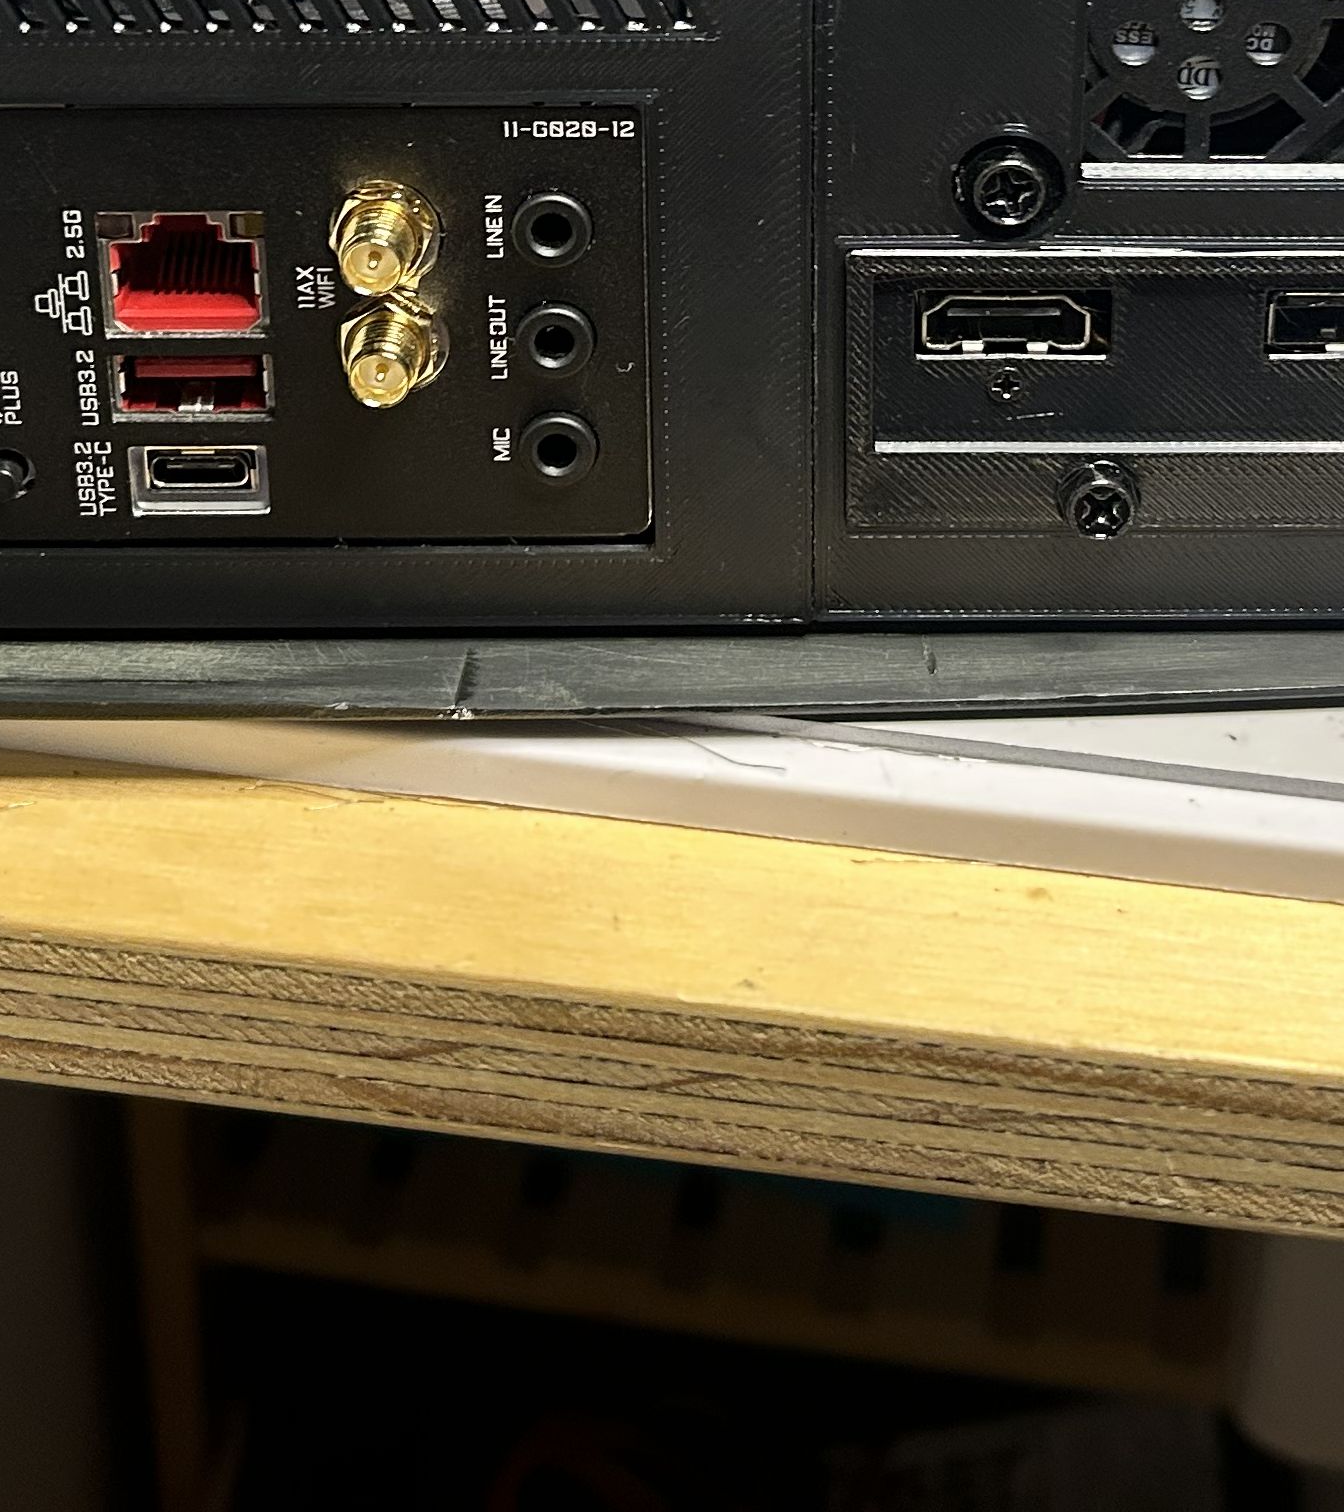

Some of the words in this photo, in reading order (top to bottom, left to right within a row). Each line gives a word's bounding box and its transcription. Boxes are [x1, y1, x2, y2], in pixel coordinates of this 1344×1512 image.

[484, 194, 504, 214] IN
[62, 209, 85, 259] 2.5G
[485, 216, 504, 260] LINE
[316, 267, 336, 310] WIFI
[487, 294, 508, 336] OUT
[489, 337, 509, 381] LINE
[75, 348, 101, 427] USB3.2
[491, 427, 512, 462] MIC
[73, 441, 98, 517] USB3.2
[95, 440, 117, 517] TYPE-C
